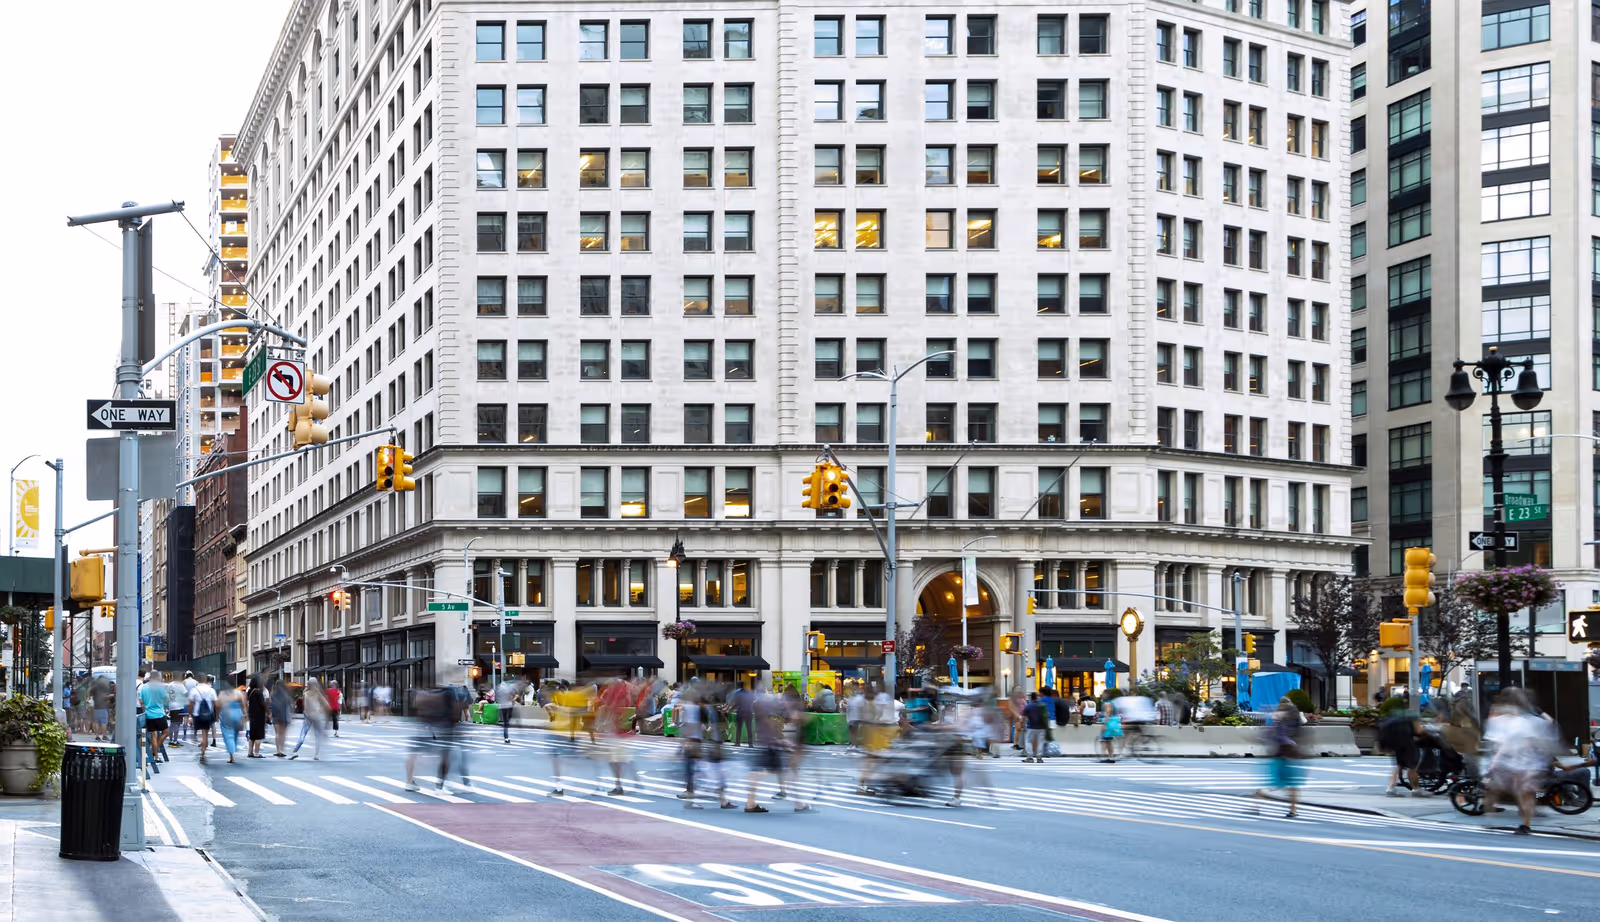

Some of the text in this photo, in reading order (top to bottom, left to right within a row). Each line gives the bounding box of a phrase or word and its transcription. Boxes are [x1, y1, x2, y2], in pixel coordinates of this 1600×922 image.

[252, 361, 257, 382] 23
[100, 408, 165, 421] ONE WAY
[1505, 494, 1534, 506] Broadway
[1509, 506, 1541, 520] E 23 St
[1476, 537, 1491, 545] ONE
[633, 863, 961, 906] BUS
